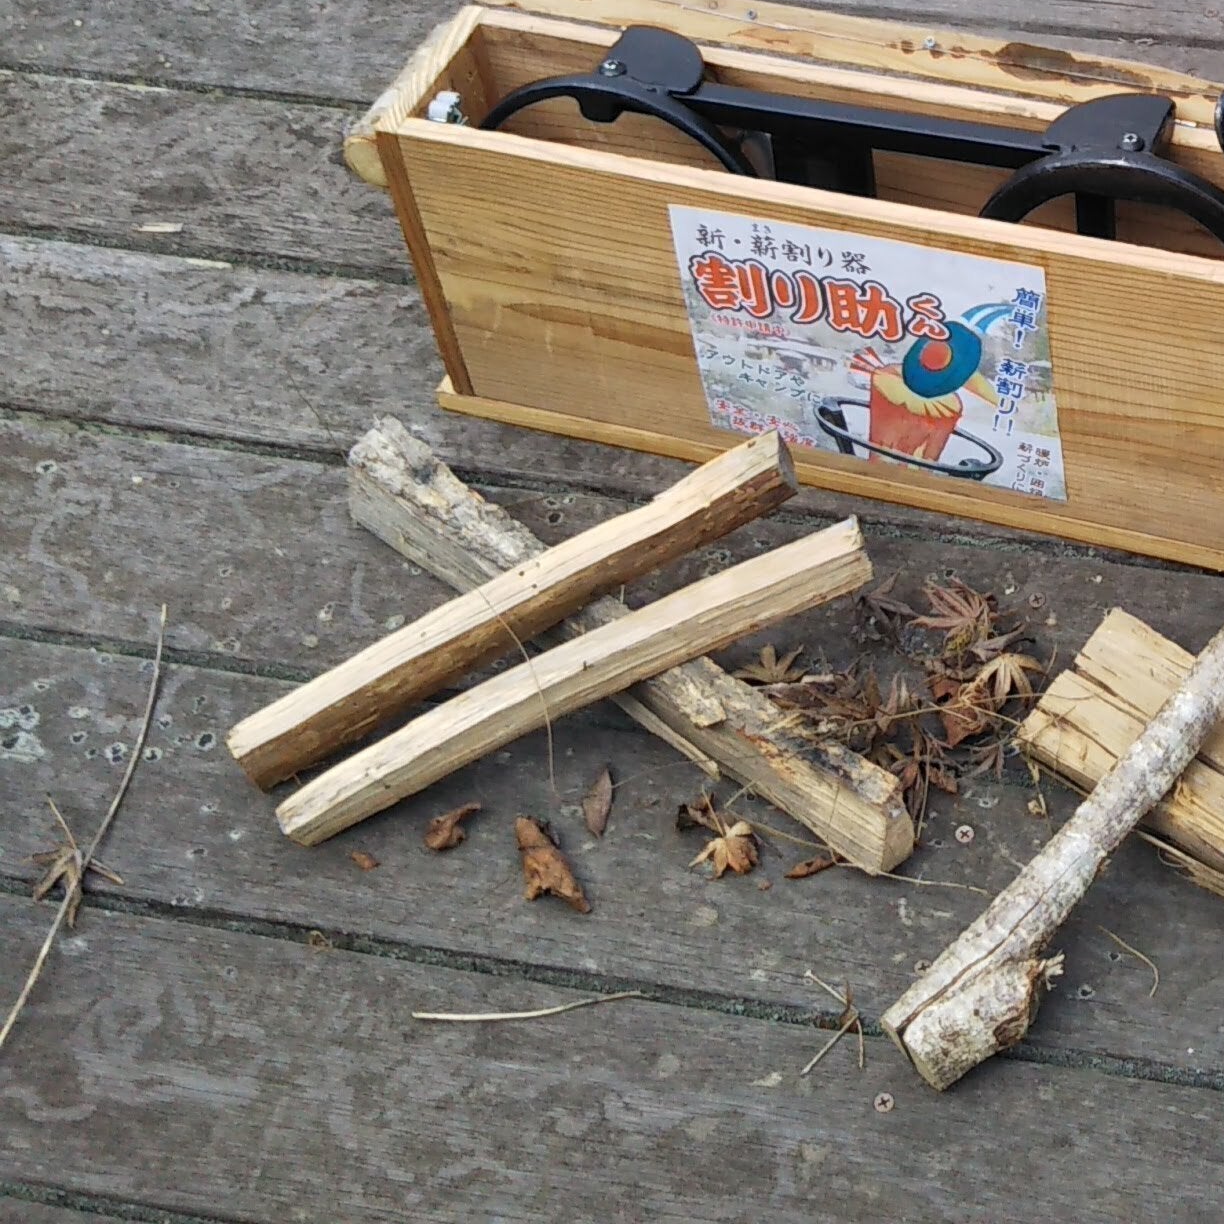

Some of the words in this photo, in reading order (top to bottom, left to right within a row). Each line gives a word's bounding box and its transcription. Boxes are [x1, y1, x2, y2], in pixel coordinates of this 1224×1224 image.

[696, 223, 872, 275] 新・薪割り器
[688, 249, 952, 343] 割り助くん
[706, 348, 805, 386] アウトドアや
